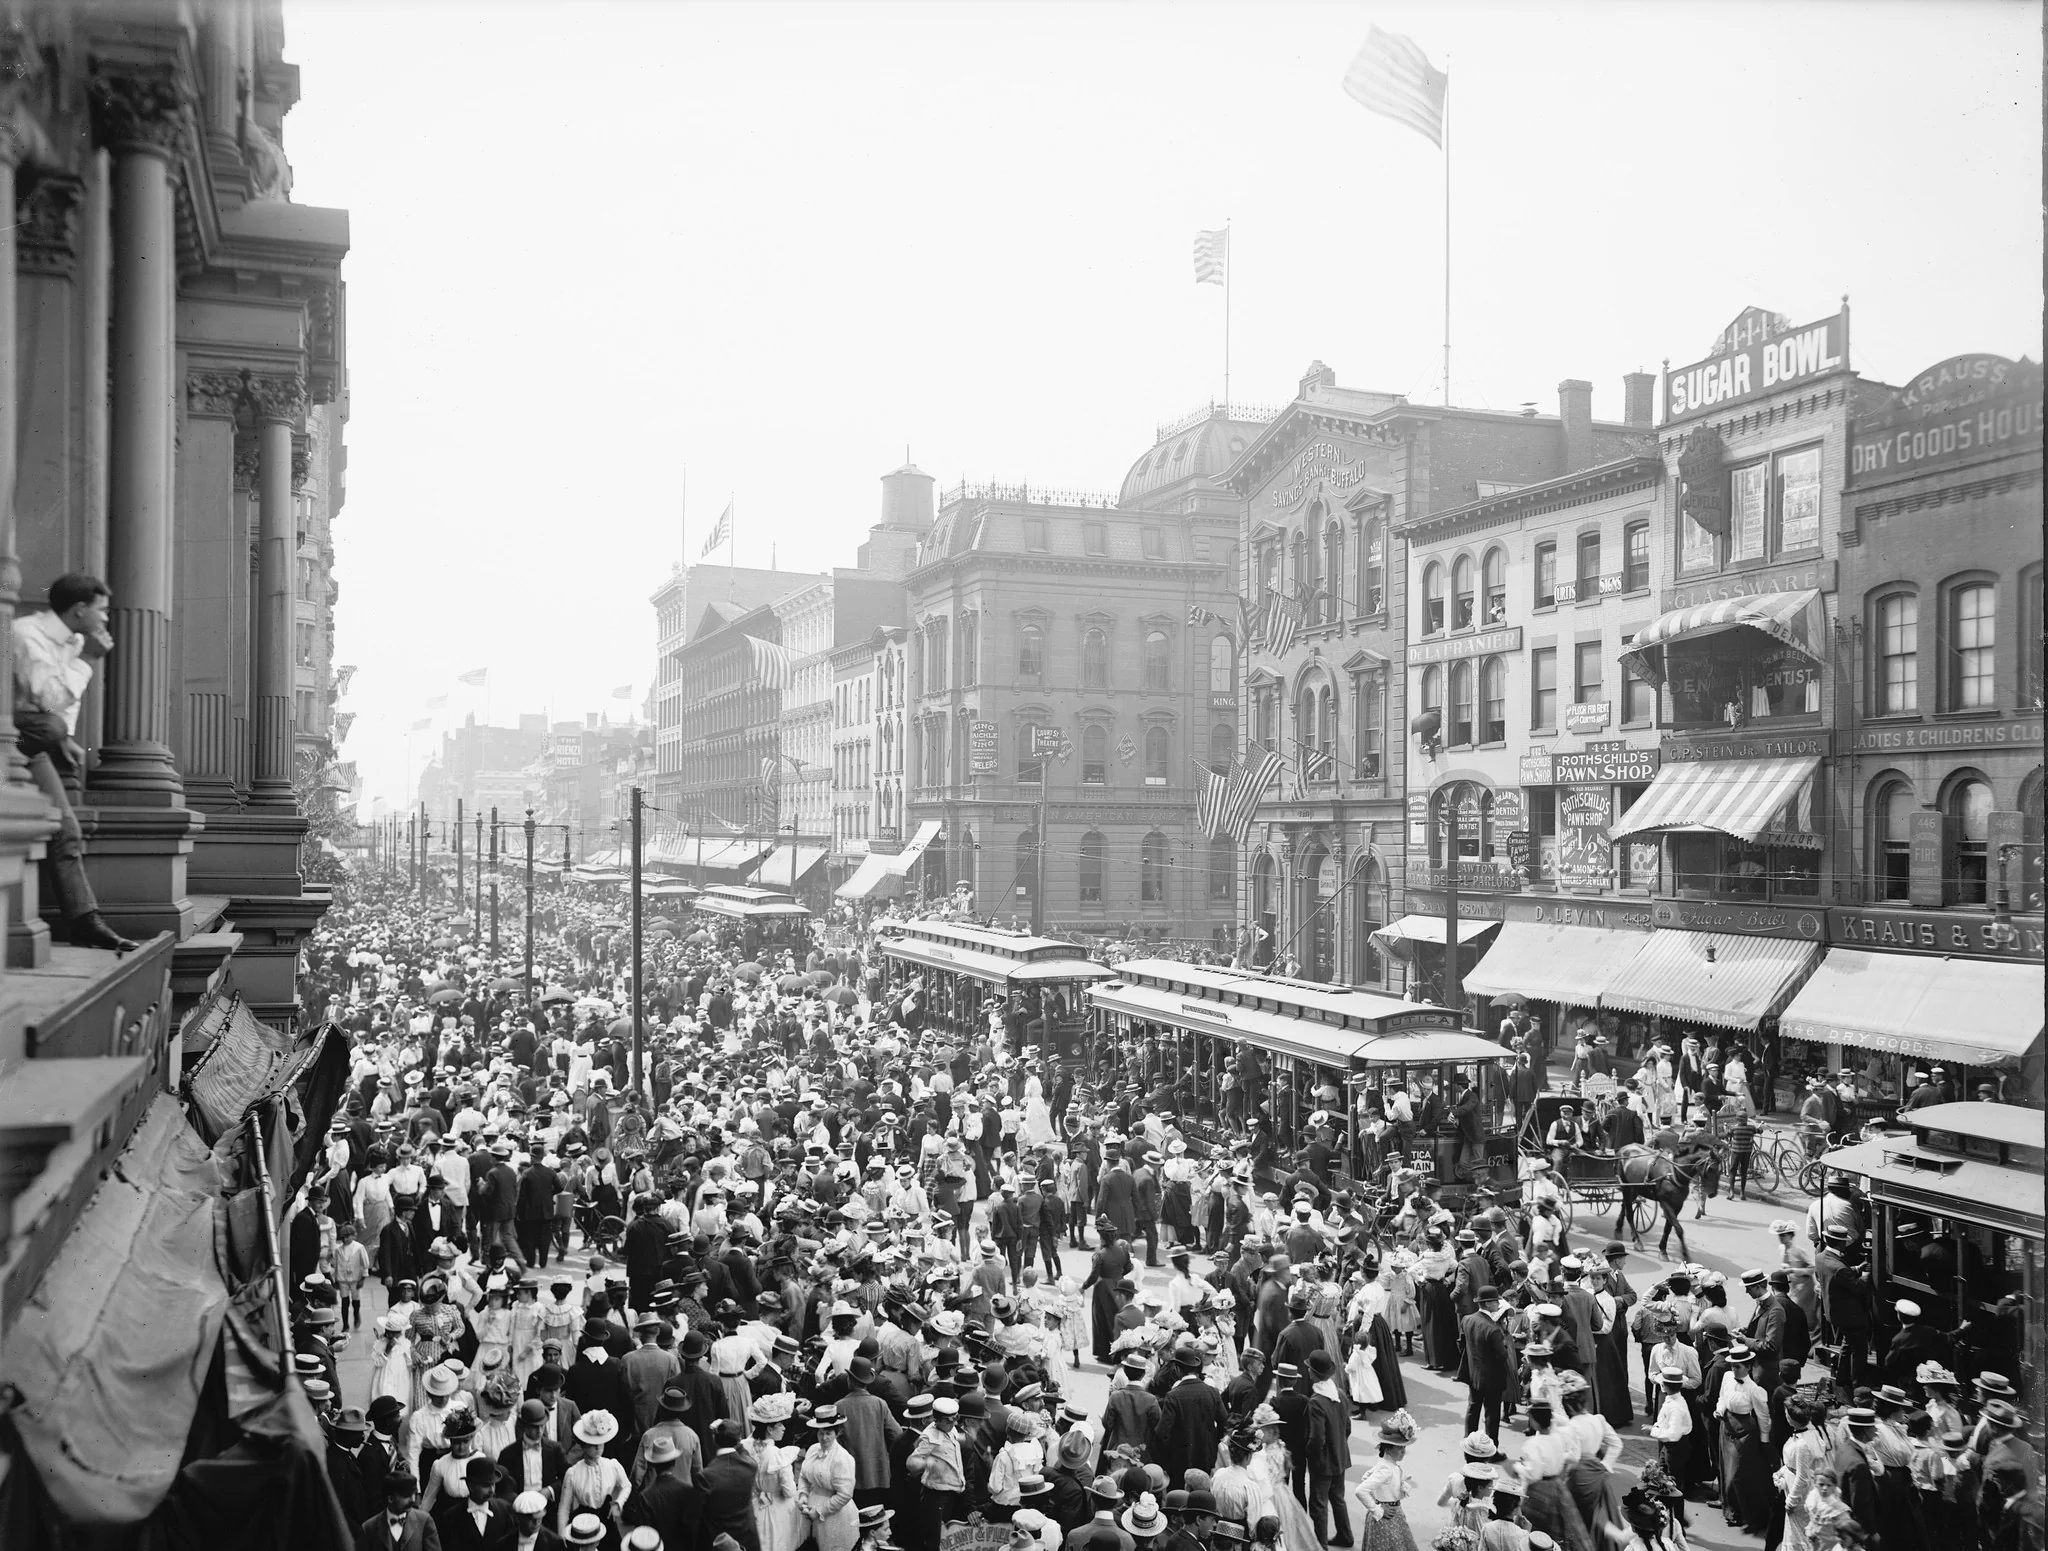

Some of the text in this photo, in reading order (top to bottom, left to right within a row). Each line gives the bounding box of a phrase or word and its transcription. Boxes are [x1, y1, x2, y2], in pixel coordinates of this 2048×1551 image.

[1727, 313, 1769, 351] 444
[1671, 353, 1751, 415] SUGAR
[1902, 358, 2008, 410] KRAUS'S
[1852, 440, 1893, 475] DRY
[1896, 419, 1973, 464] GOODS
[1293, 443, 1341, 478] WESTERN
[1272, 480, 1304, 508] SAVINGS
[1304, 463, 1325, 488] BANK
[1331, 459, 1366, 489] BUFFALO
[1555, 584, 1577, 603] CURTIS
[1600, 575, 1622, 595] SIGNS
[1674, 571, 1818, 610] GLASSWARE
[1409, 632, 1516, 662] DE LA FRANIER
[1786, 650, 1807, 664] BELL
[1759, 668, 1814, 688] DENTIST
[1213, 697, 1236, 706] KING.
[1571, 705, 1587, 715] FLOOR
[1587, 704, 1597, 714] FOR
[1597, 703, 1609, 713] RENT
[1036, 729, 1052, 738] COURT
[1906, 729, 1915, 746] &
[1919, 727, 2006, 746] CHILDRENS
[2010, 724, 2044, 741] CLO
[556, 746, 581, 755] RIENZI
[1036, 740, 1059, 748] THEATRE
[1591, 743, 1620, 753] 442
[1696, 746, 1735, 759] STEIN
[1739, 743, 1758, 756] JR.
[1766, 740, 1822, 755] TAILOR.
[556, 757, 581, 765] HOTEL
[1561, 751, 1649, 766] ROTHSCHILD'S
[1521, 768, 1534, 783] PAWN
[1556, 766, 1598, 782] PAWN
[1495, 807, 1519, 816] DENTIST
[1561, 793, 1611, 816] ROTHSCHILD'S
[1003, 809, 1178, 822] GERN AMERICAN BANK
[1567, 812, 1603, 826] PAWN SHOP
[1917, 819, 1936, 829] 446
[1914, 848, 1937, 862] FIRE
[1556, 908, 1605, 926] LEVIN
[1622, 912, 1650, 927] 442
[1680, 906, 1732, 926] Sugar
[1740, 910, 1787, 926] Bowl
[1841, 916, 1935, 945] KRAUS
[1951, 924, 1969, 947] &
[1623, 999, 1648, 1011] ICE
[1649, 1001, 1690, 1017] CREAM
[1391, 1014, 1450, 1026] UTICA
[1783, 1023, 1814, 1036] 446
[1828, 1029, 1870, 1044] DRY
[1410, 1151, 1432, 1159] TICA
[975, 1527, 985, 1541] &
